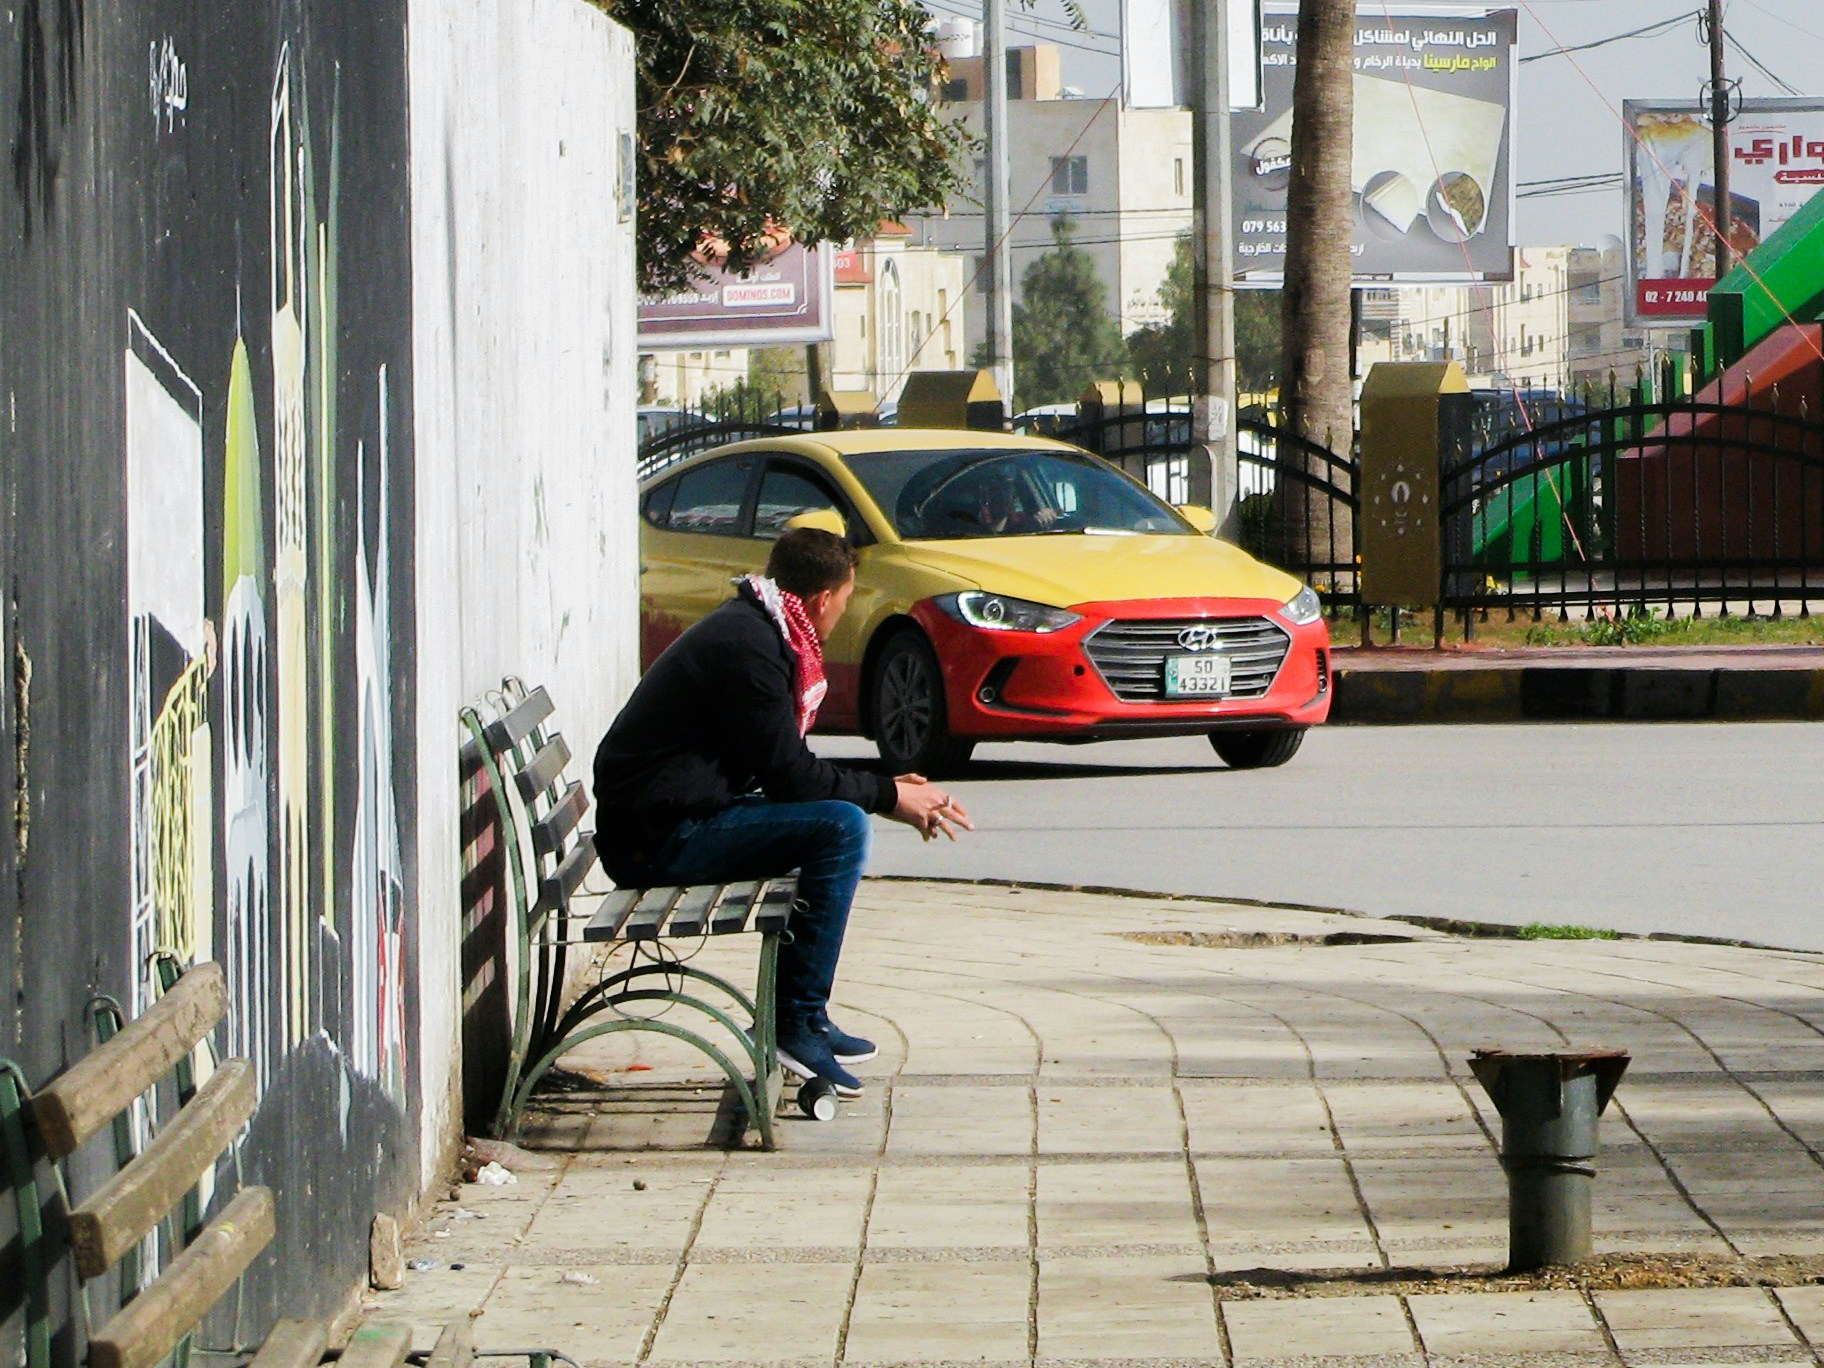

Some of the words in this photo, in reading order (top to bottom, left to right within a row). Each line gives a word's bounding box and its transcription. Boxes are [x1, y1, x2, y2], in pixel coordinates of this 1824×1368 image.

[1352, 29, 1410, 47] لمشاكل
[1411, 30, 1465, 52] النهائي
[1466, 31, 1498, 49] الحل
[1423, 53, 1471, 74] مارسينا
[1242, 220, 1264, 233] 079
[1645, 290, 1659, 303] 02
[1665, 290, 1674, 303] 7
[1179, 677, 1225, 691] 43321
